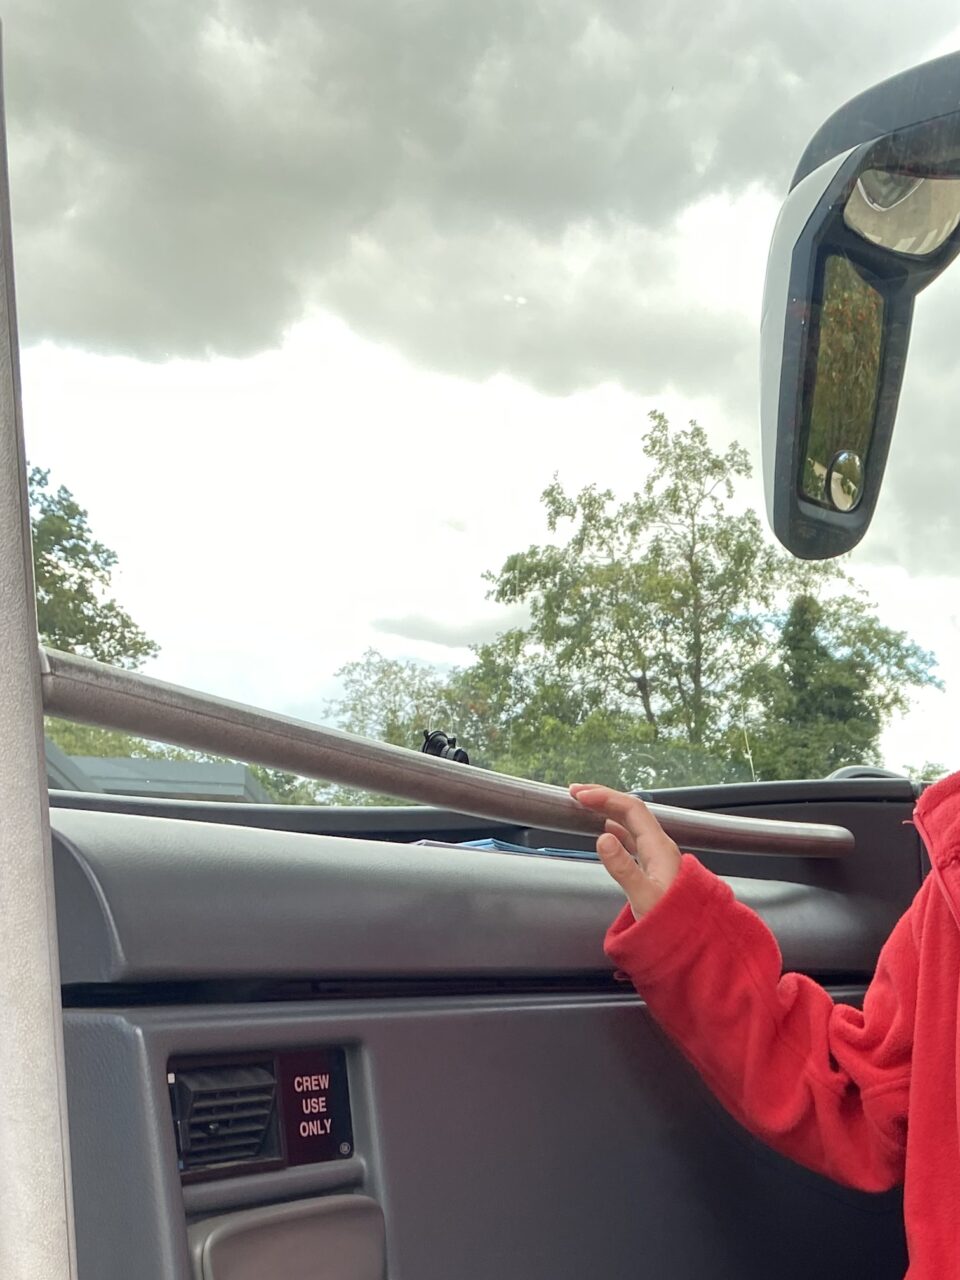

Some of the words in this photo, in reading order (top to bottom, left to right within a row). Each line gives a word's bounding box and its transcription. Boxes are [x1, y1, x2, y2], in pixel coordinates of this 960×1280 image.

[294, 1074, 330, 1093] CREW
[302, 1096, 327, 1114] USE
[299, 1118, 332, 1137] ONLY
